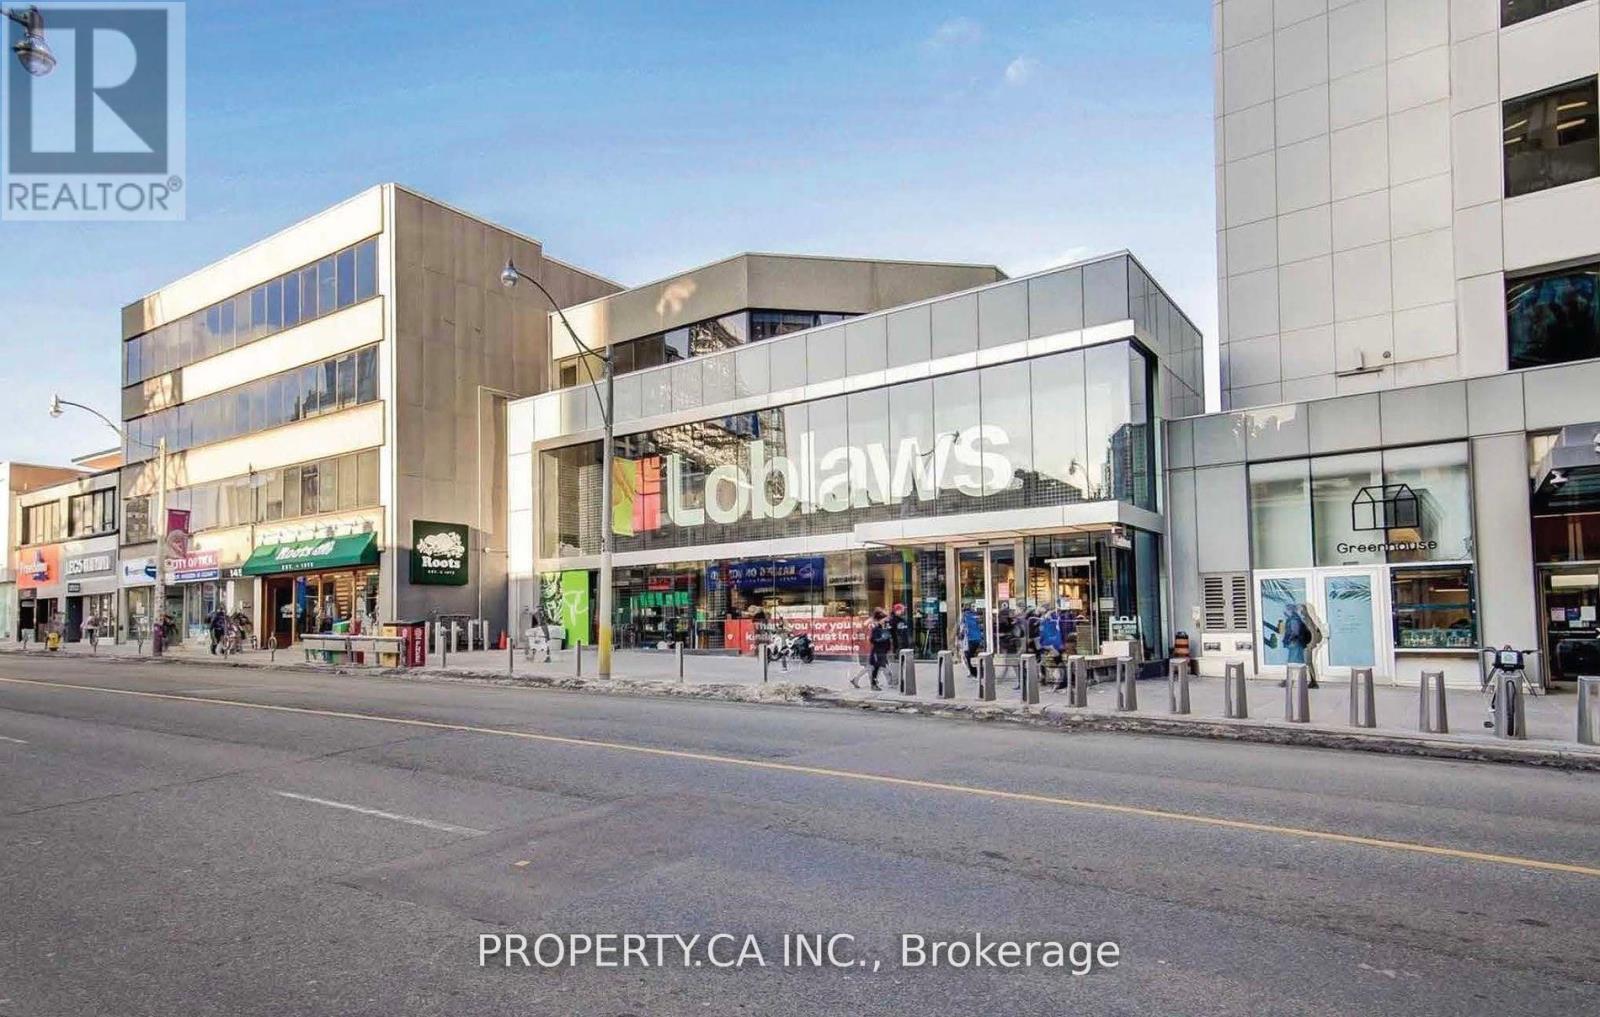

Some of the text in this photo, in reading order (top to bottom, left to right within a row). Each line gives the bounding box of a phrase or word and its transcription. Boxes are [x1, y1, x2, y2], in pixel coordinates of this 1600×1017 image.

[666, 424, 1013, 527] Loblaws
[1336, 540, 1438, 553] Greenhouse
[421, 556, 461, 569] Roots
[838, 632, 850, 640] in
